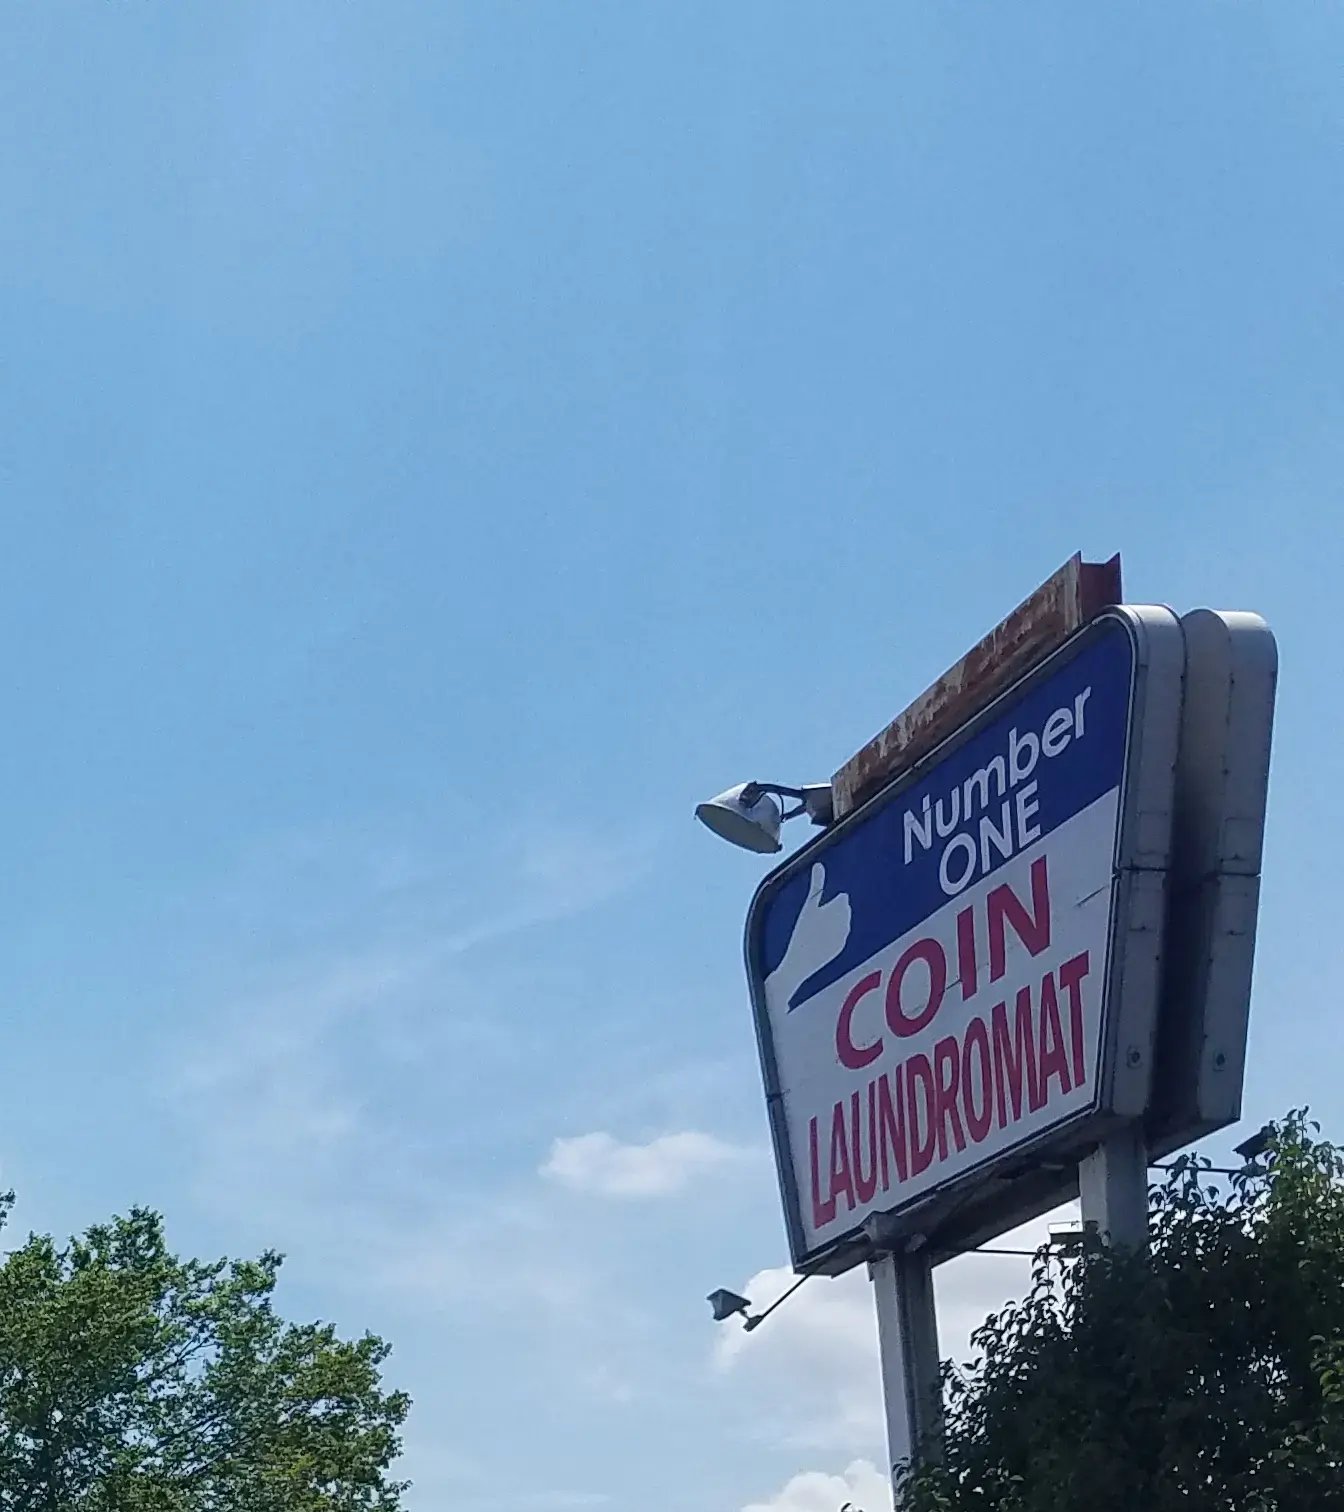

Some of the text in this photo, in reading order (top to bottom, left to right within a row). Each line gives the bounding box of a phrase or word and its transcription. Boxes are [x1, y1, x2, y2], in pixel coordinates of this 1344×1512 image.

[903, 686, 1092, 866] Number
[938, 779, 1042, 896] ONE
[835, 854, 1051, 1070] COIN
[809, 950, 1090, 1230] LAUNDROMAT
